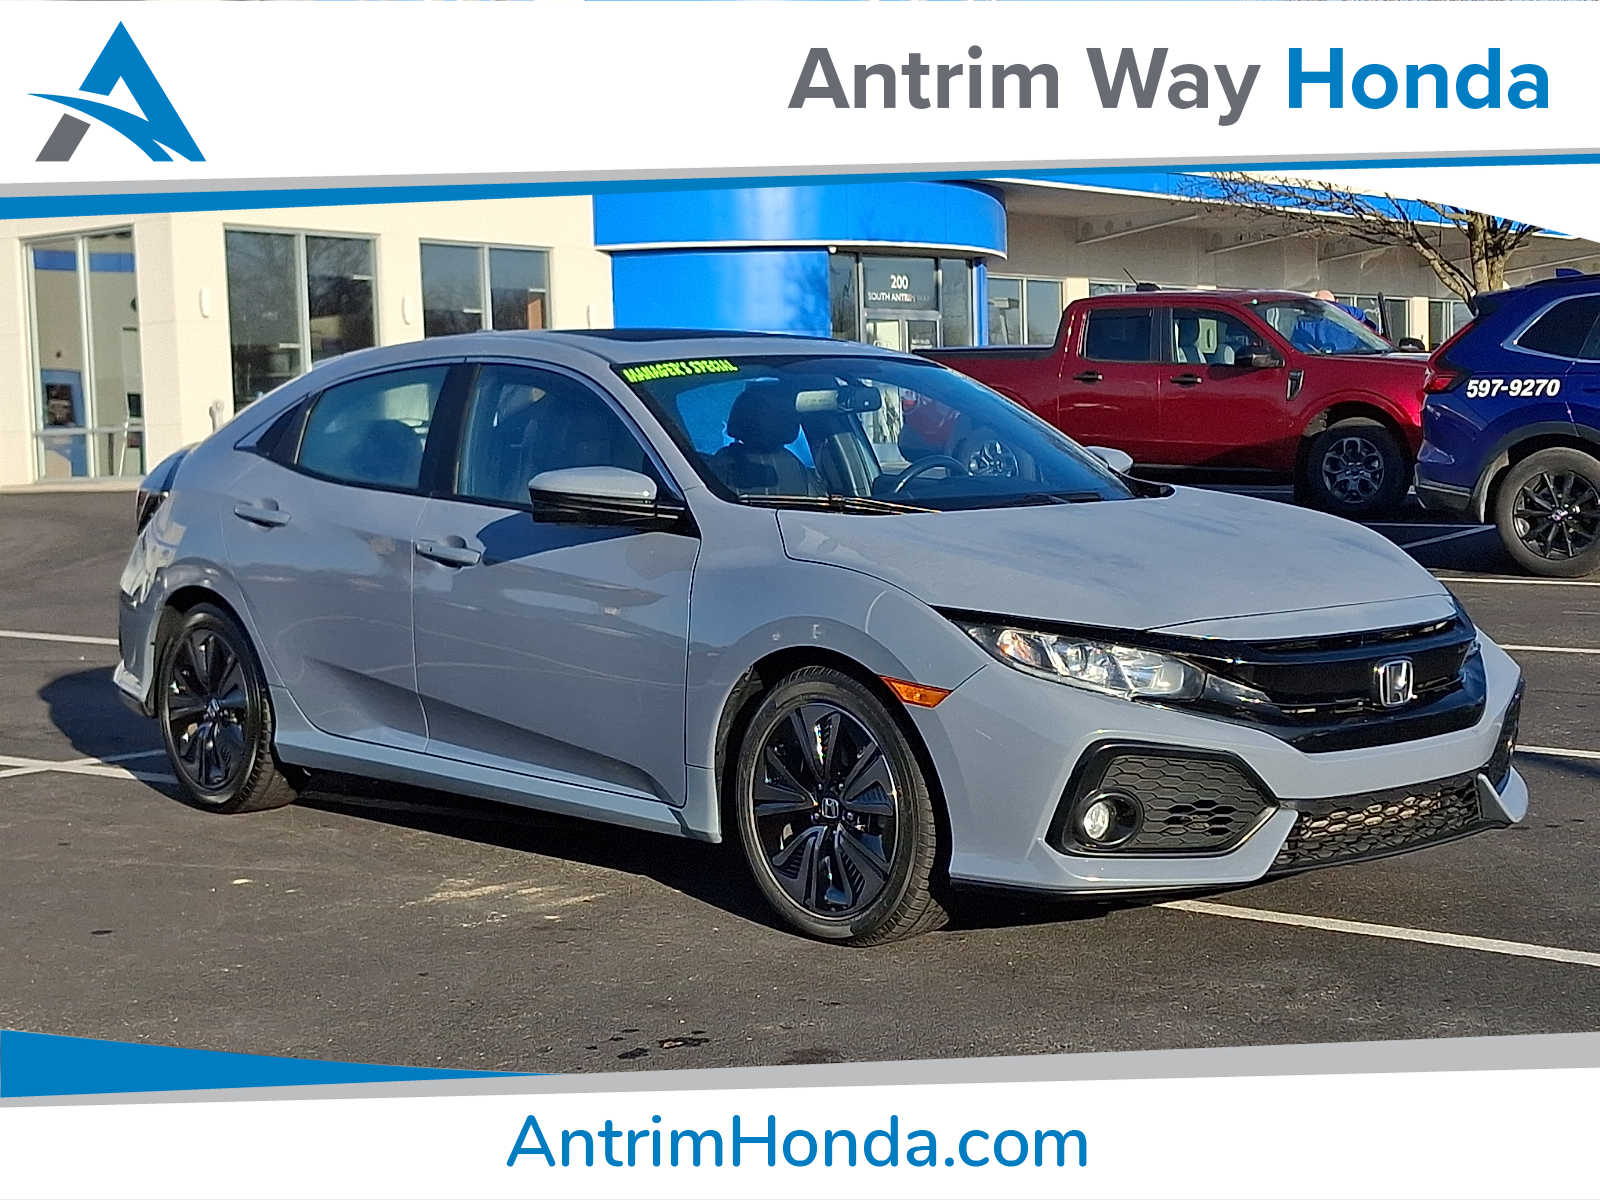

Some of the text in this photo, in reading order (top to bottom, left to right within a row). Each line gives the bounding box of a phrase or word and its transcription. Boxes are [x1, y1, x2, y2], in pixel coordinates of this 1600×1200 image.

[890, 274, 909, 290] 200
[867, 291, 891, 301] SOUTH
[688, 359, 739, 374] SPECIAL
[1466, 378, 1561, 398] 597-9270
